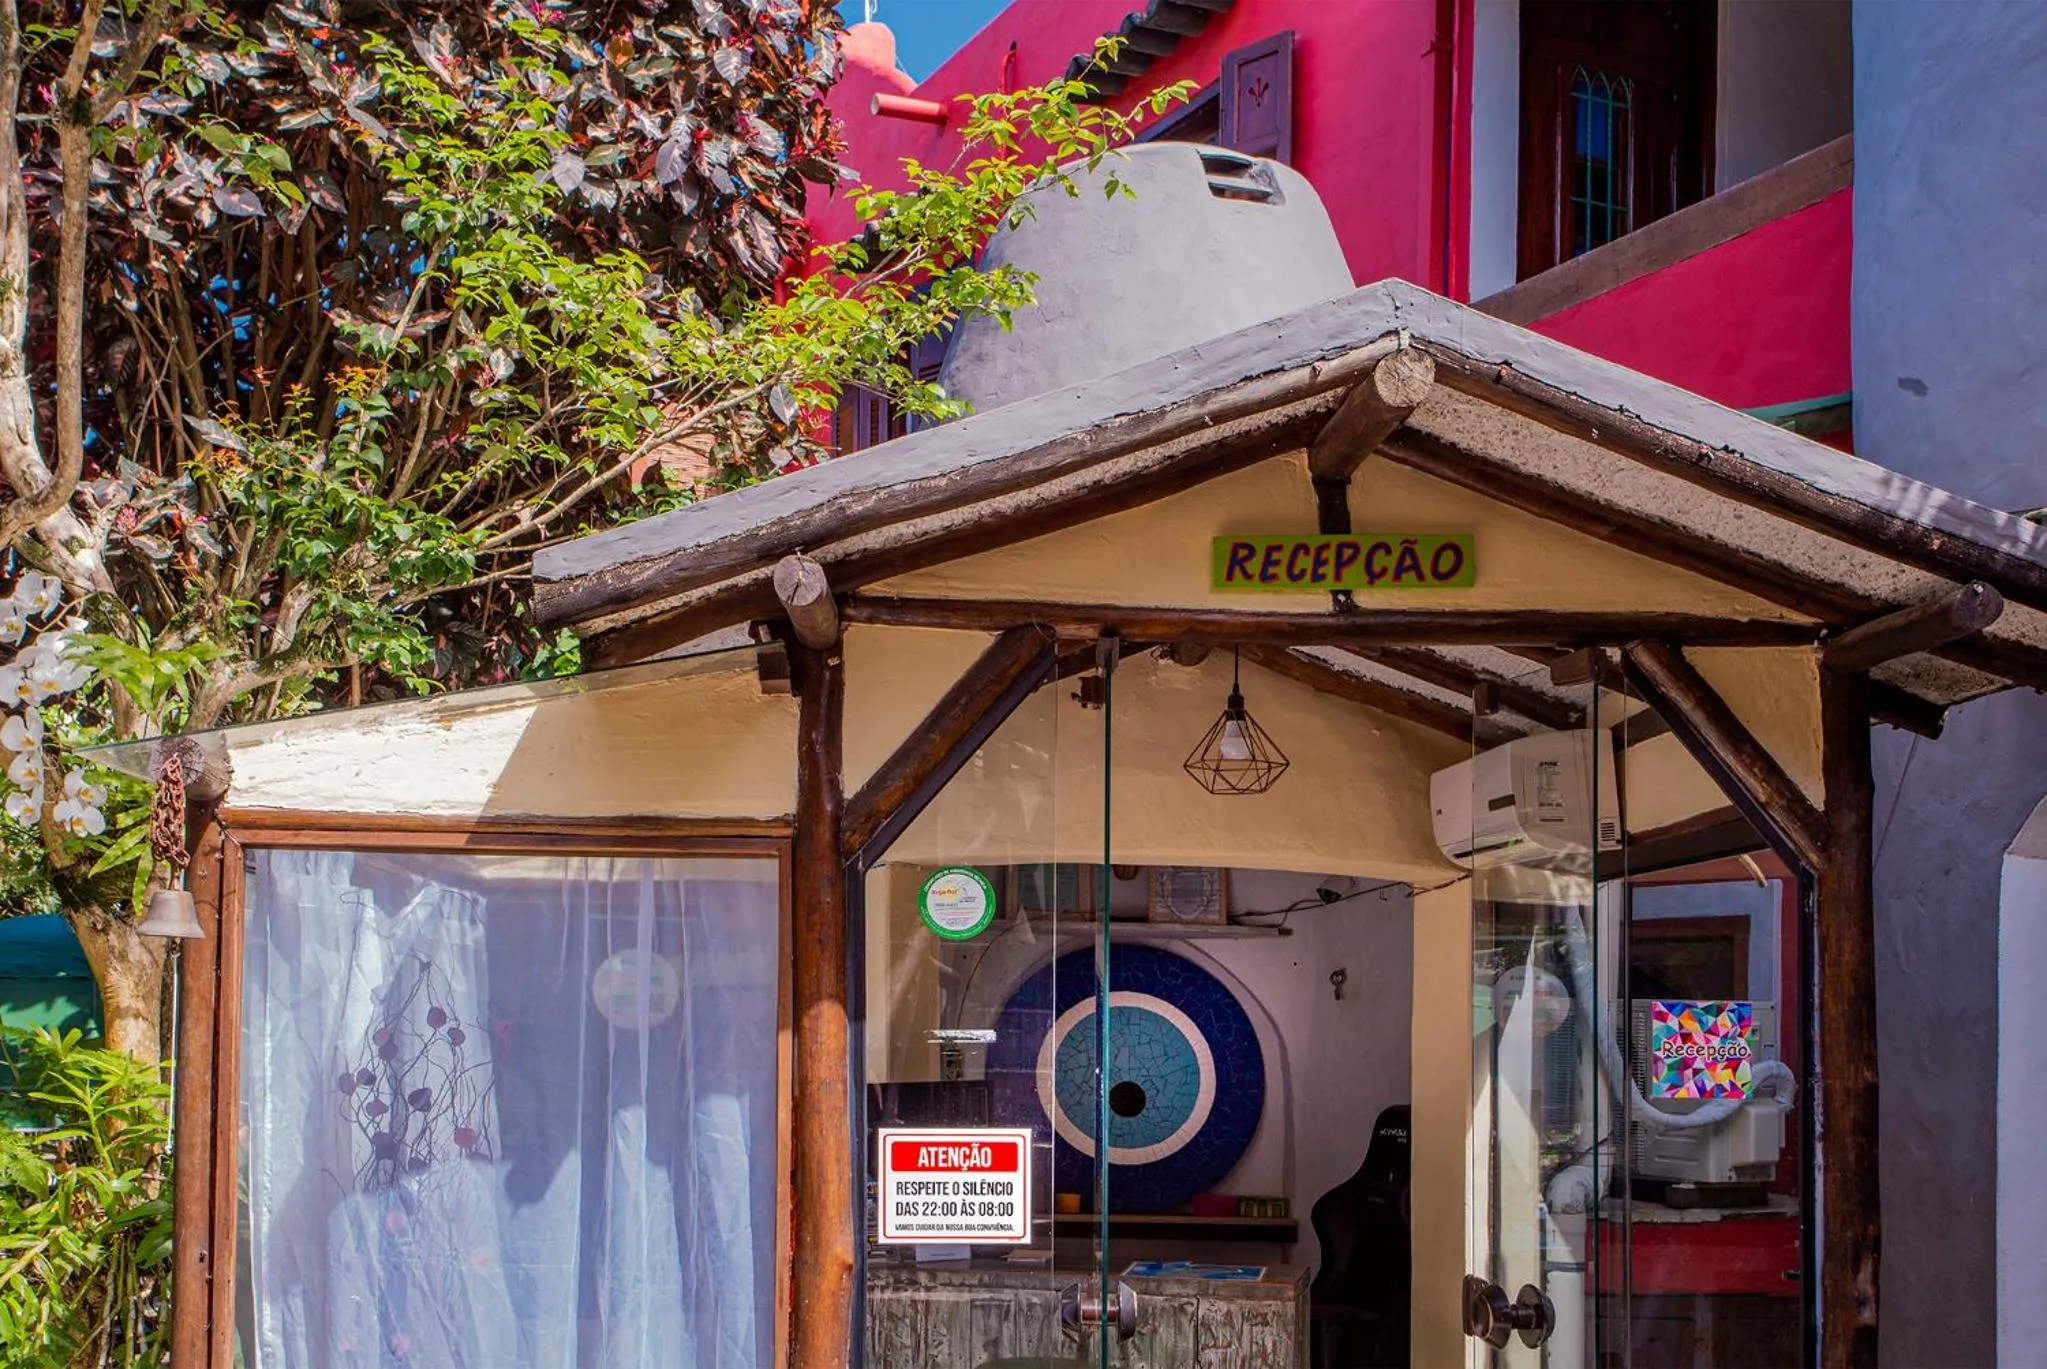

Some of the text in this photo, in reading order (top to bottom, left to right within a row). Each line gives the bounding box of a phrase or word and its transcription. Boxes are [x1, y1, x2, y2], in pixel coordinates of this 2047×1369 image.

[1224, 538, 1465, 586] RECEPÇÃO
[1662, 1041, 1748, 1061] Recepção
[917, 1142, 992, 1172] ATENÇÃO
[896, 1178, 1014, 1196] RESPEITE O SILÊNCIO
[895, 1198, 1014, 1217] DAS 22:00 ÀS 08:00
